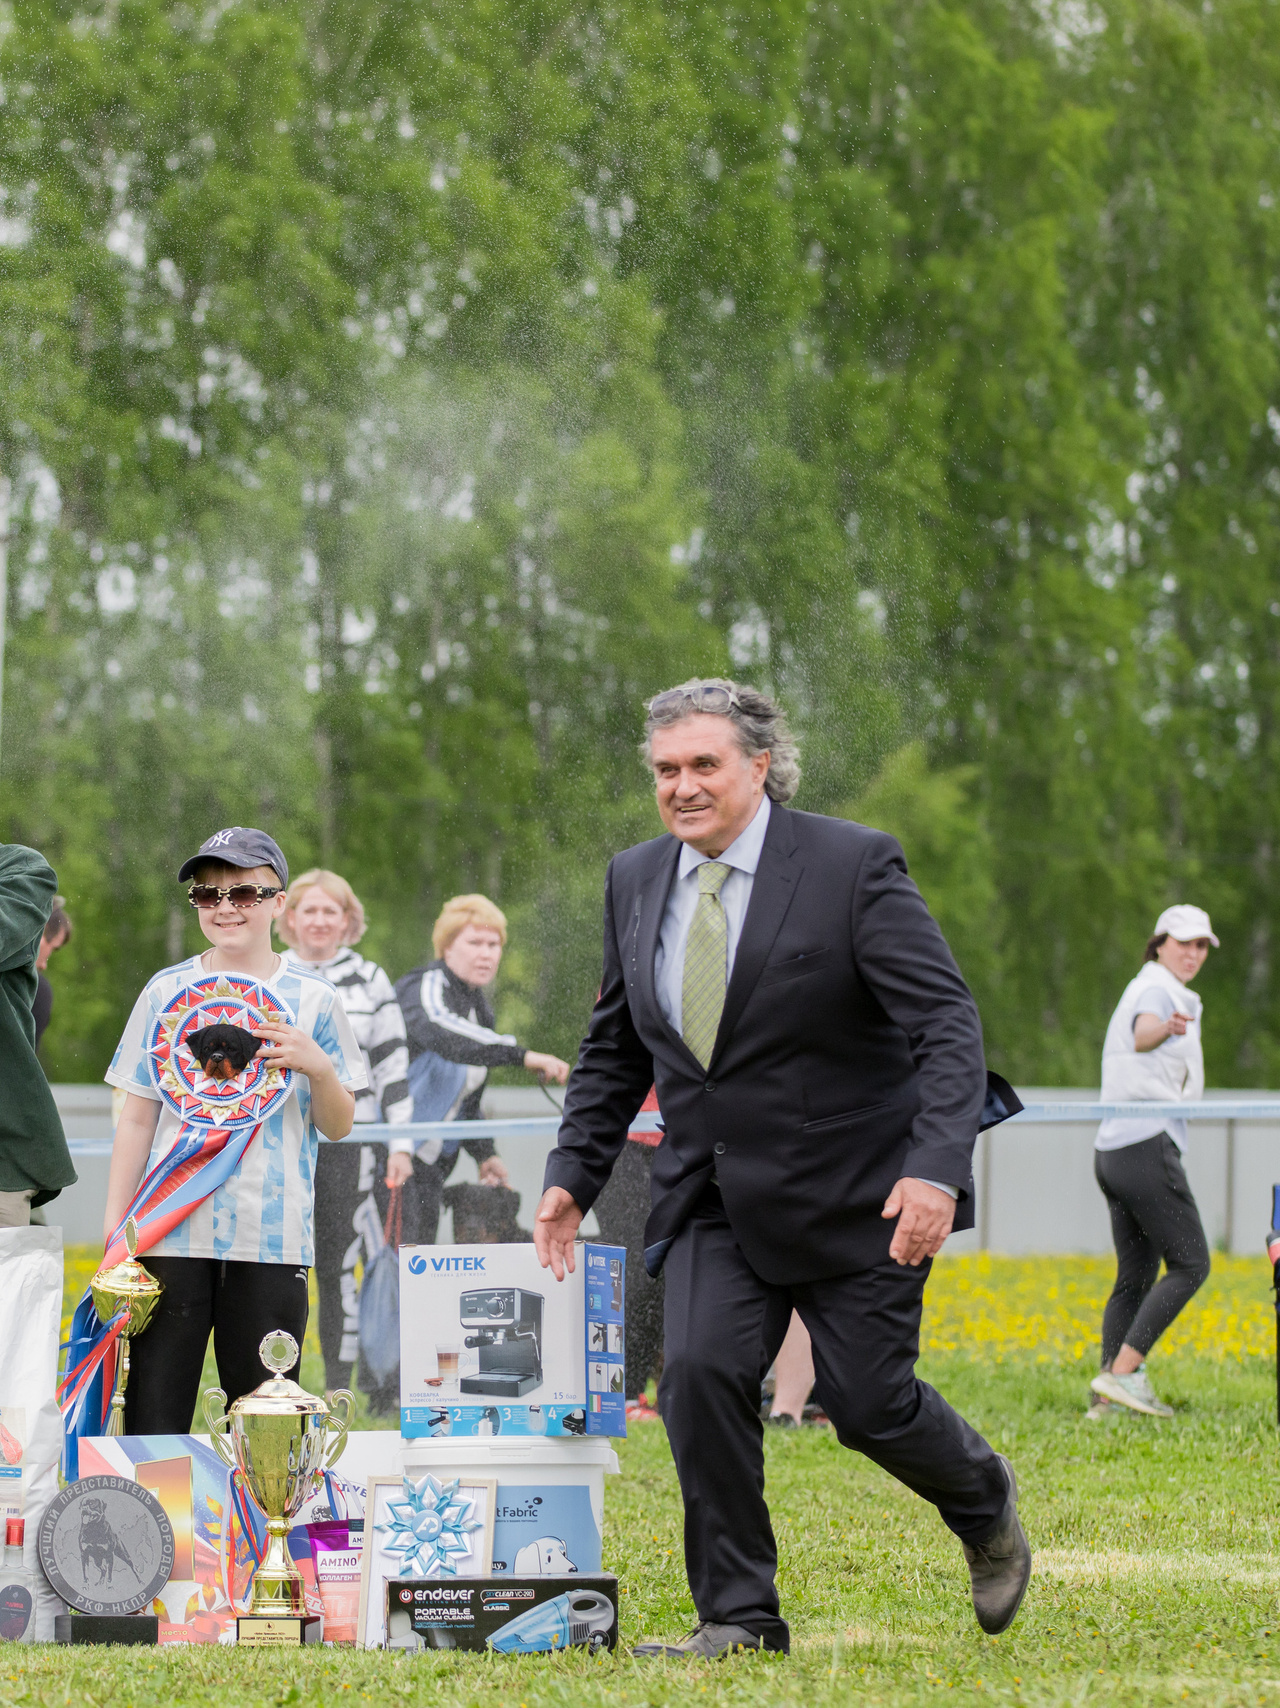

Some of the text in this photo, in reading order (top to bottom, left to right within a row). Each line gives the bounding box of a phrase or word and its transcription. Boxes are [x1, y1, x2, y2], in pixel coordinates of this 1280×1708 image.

[430, 1256, 486, 1271] VITEK
[553, 1391, 564, 1400] 15
[404, 1409, 412, 1422] 1
[453, 1408, 462, 1421] 2
[503, 1407, 512, 1421] 3
[548, 1406, 557, 1420] 4
[59, 1477, 152, 1505] ПРЕДСТАВИТЕЛЬ
[503, 1507, 538, 1517] Fabric
[42, 1508, 60, 1576] ЛУЧШИЙ
[156, 1512, 173, 1578] ПОРОДЫ
[320, 1557, 357, 1567] AMINO
[75, 1592, 146, 1613] РКФ-НКПР
[415, 1607, 470, 1615] PORTABLE
